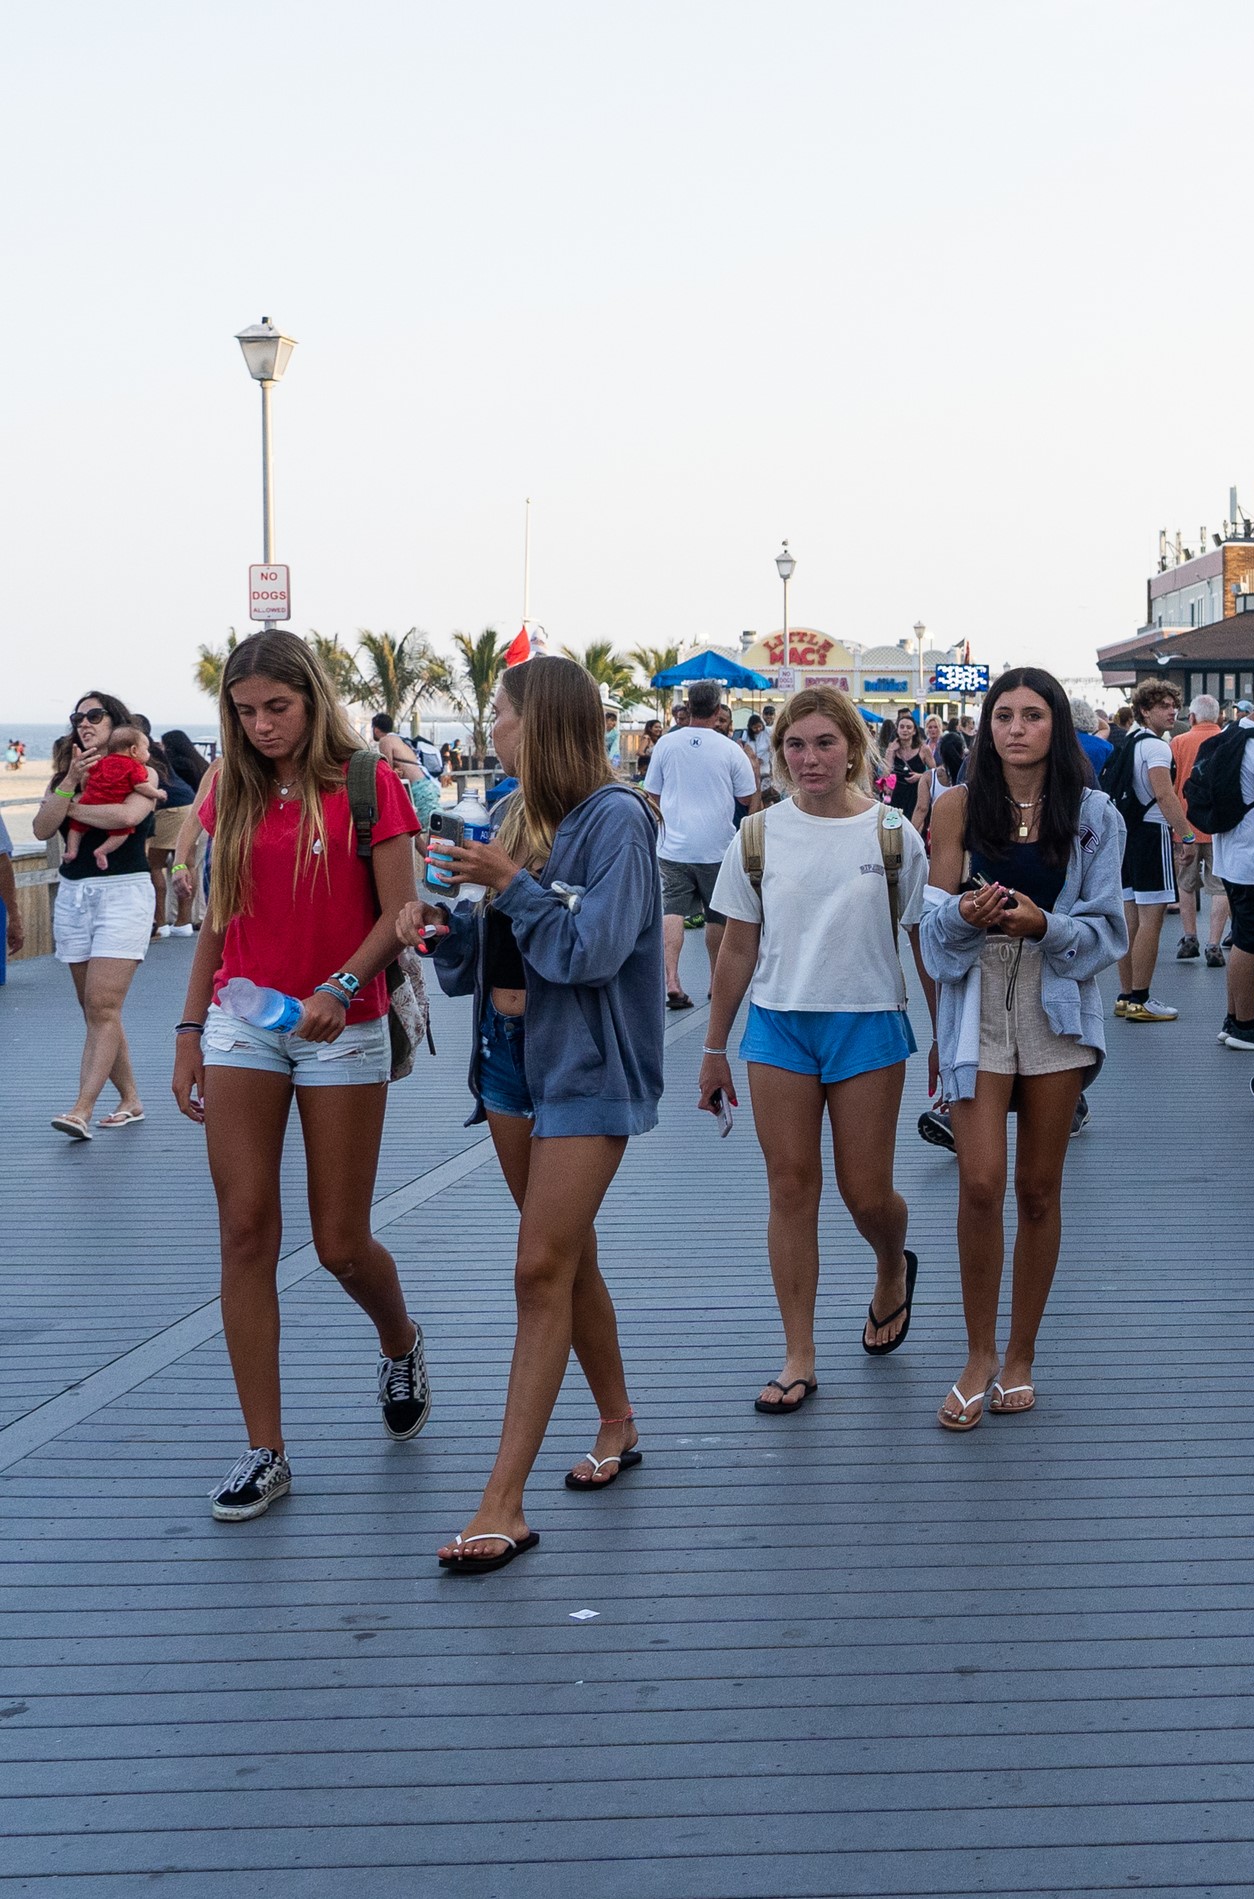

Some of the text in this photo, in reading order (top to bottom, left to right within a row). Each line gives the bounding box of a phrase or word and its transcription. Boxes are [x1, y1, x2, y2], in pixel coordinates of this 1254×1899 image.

[260, 571, 278, 581] NO
[252, 591, 287, 600] DOGS
[763, 631, 834, 653] LITTLE
